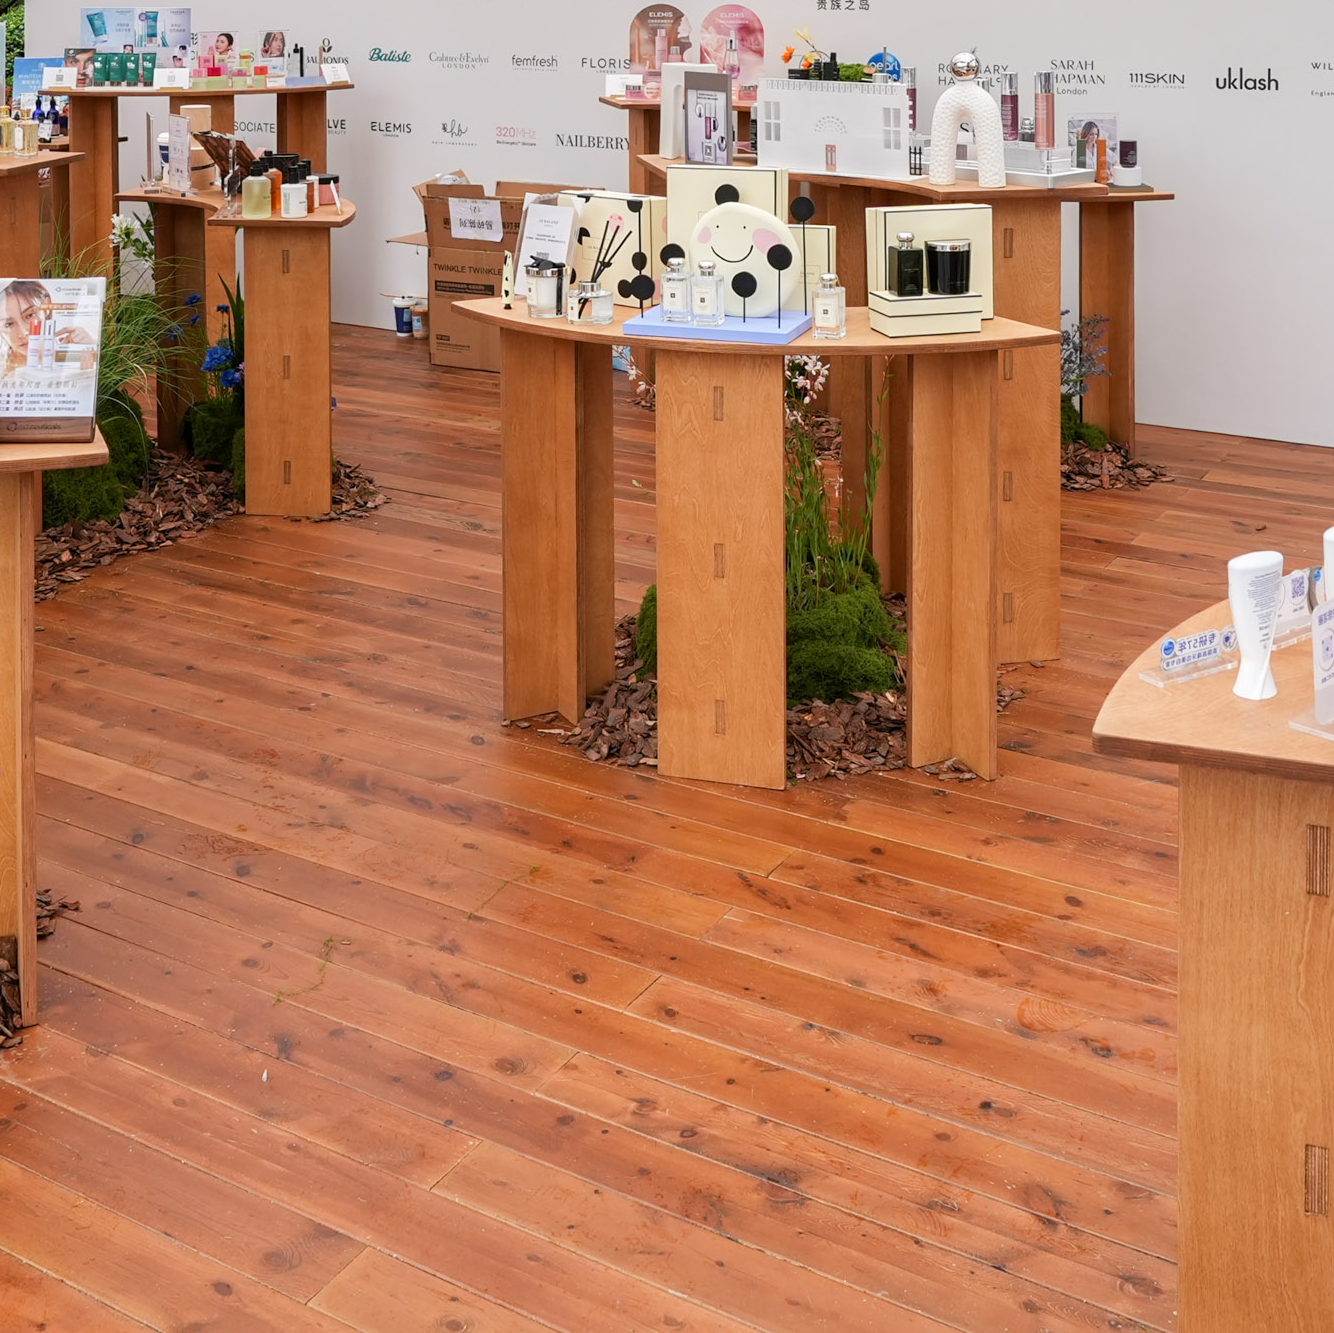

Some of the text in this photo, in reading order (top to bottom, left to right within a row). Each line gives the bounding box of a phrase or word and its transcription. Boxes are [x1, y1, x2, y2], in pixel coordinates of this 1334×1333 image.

[368, 47, 412, 63] Batiste
[511, 54, 558, 68] femfresh
[581, 57, 632, 69] FLORIS
[1050, 59, 1094, 71] SARAH
[1215, 67, 1279, 91] uklash
[1057, 87, 1088, 96] London
[234, 121, 276, 134] SOCIATE
[327, 119, 347, 130] LVE
[370, 121, 412, 134] ELEMIS
[556, 133, 631, 151] NAILBERRY
[433, 263, 466, 274] TWINKLE
